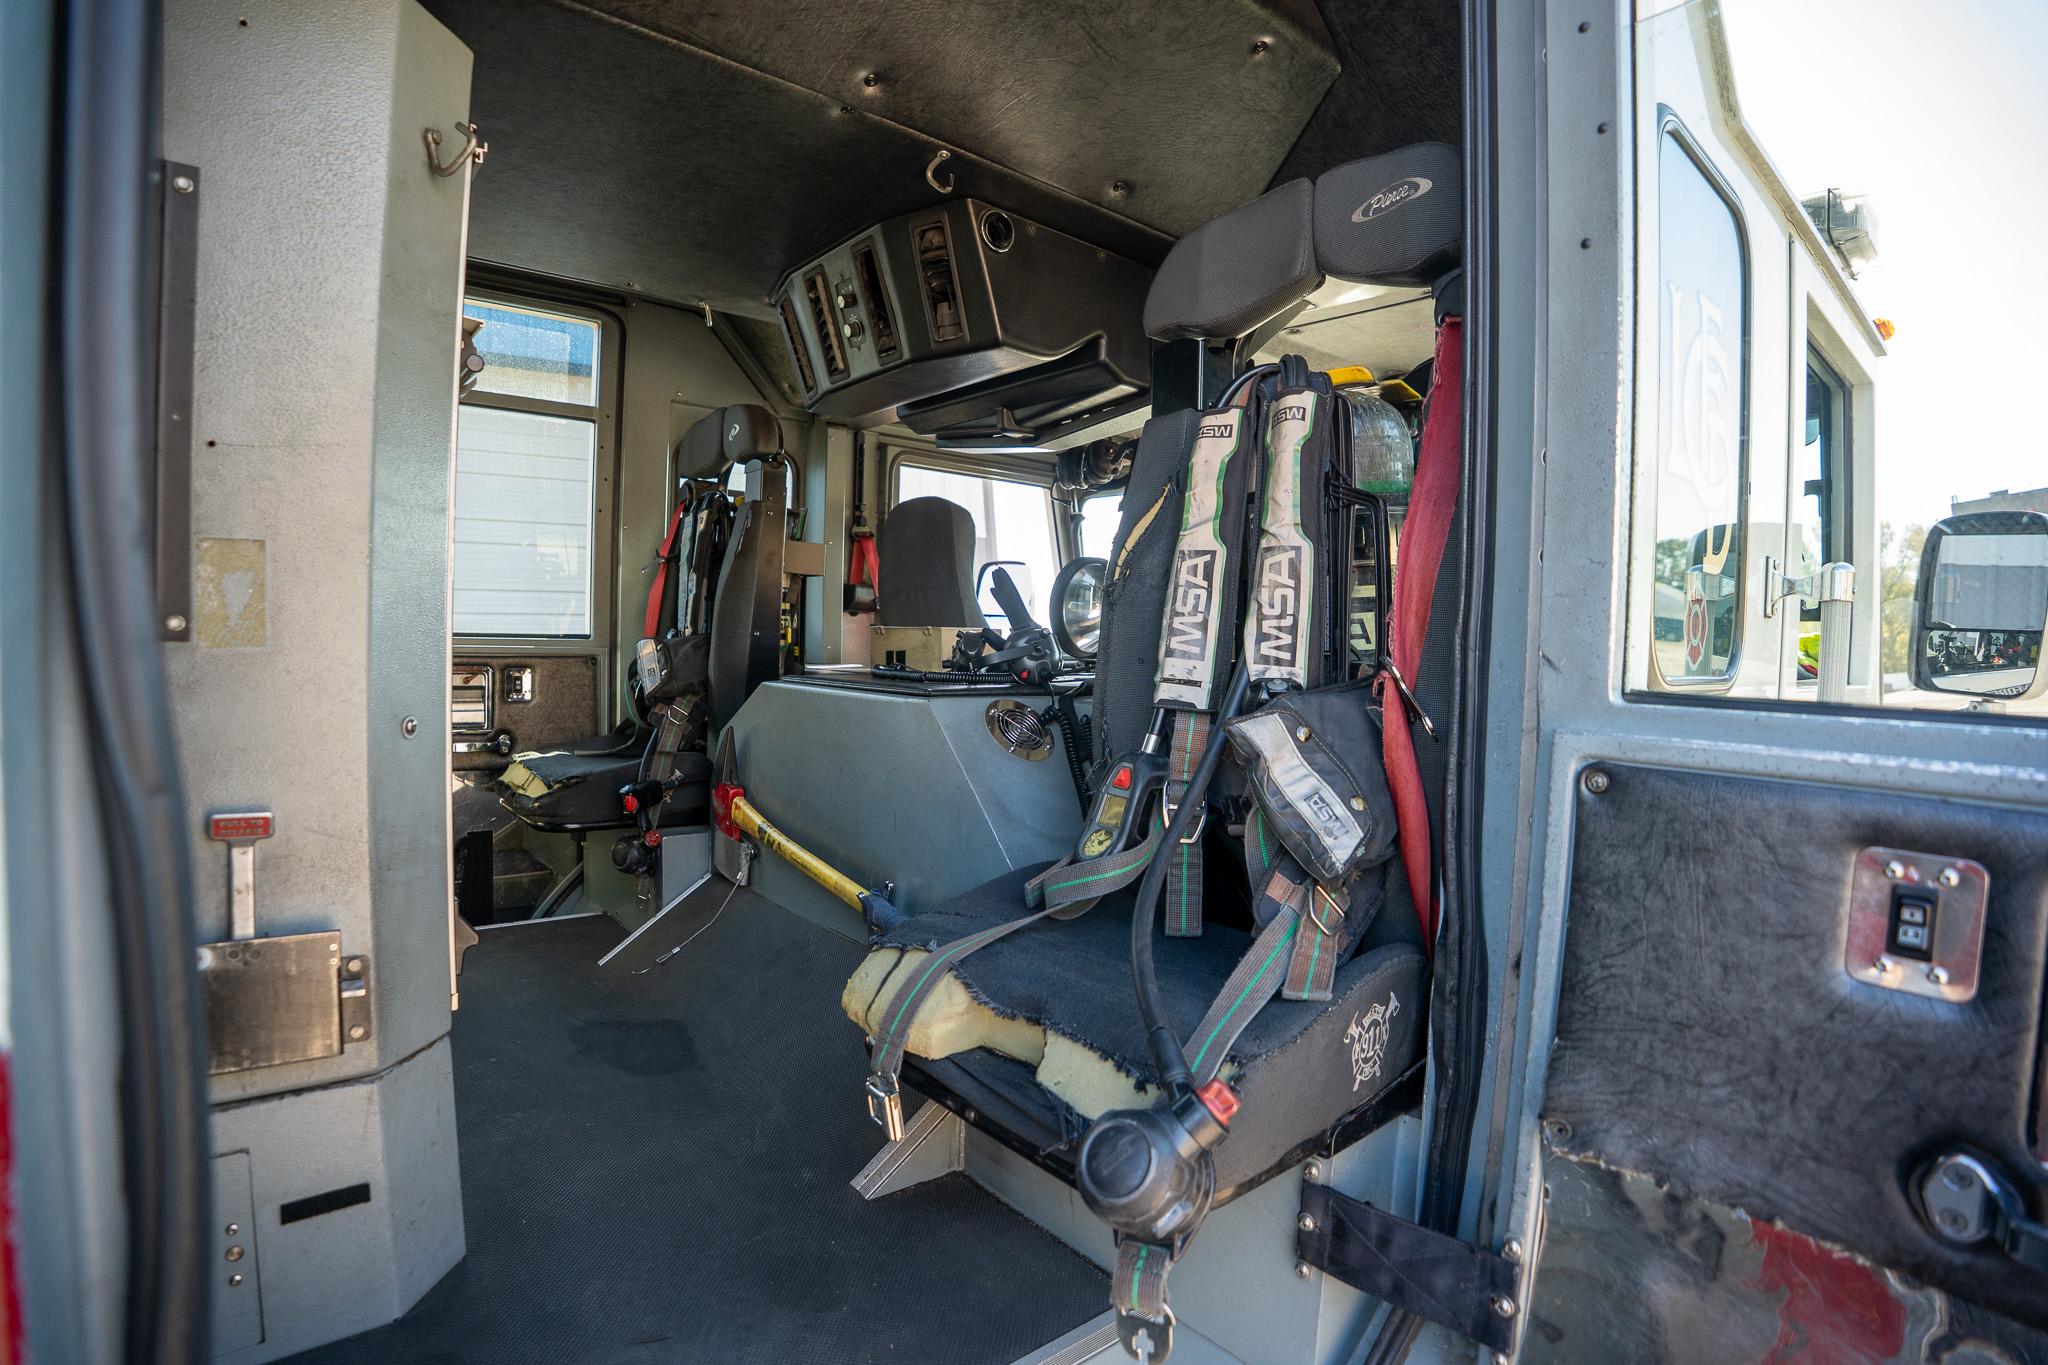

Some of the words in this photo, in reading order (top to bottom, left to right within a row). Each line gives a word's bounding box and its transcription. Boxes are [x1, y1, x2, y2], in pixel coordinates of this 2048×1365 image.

[1370, 184, 1409, 216] Pierce
[1169, 554, 1212, 654] MSA
[1260, 550, 1296, 660] MSA
[1361, 1026, 1381, 1058] 911
